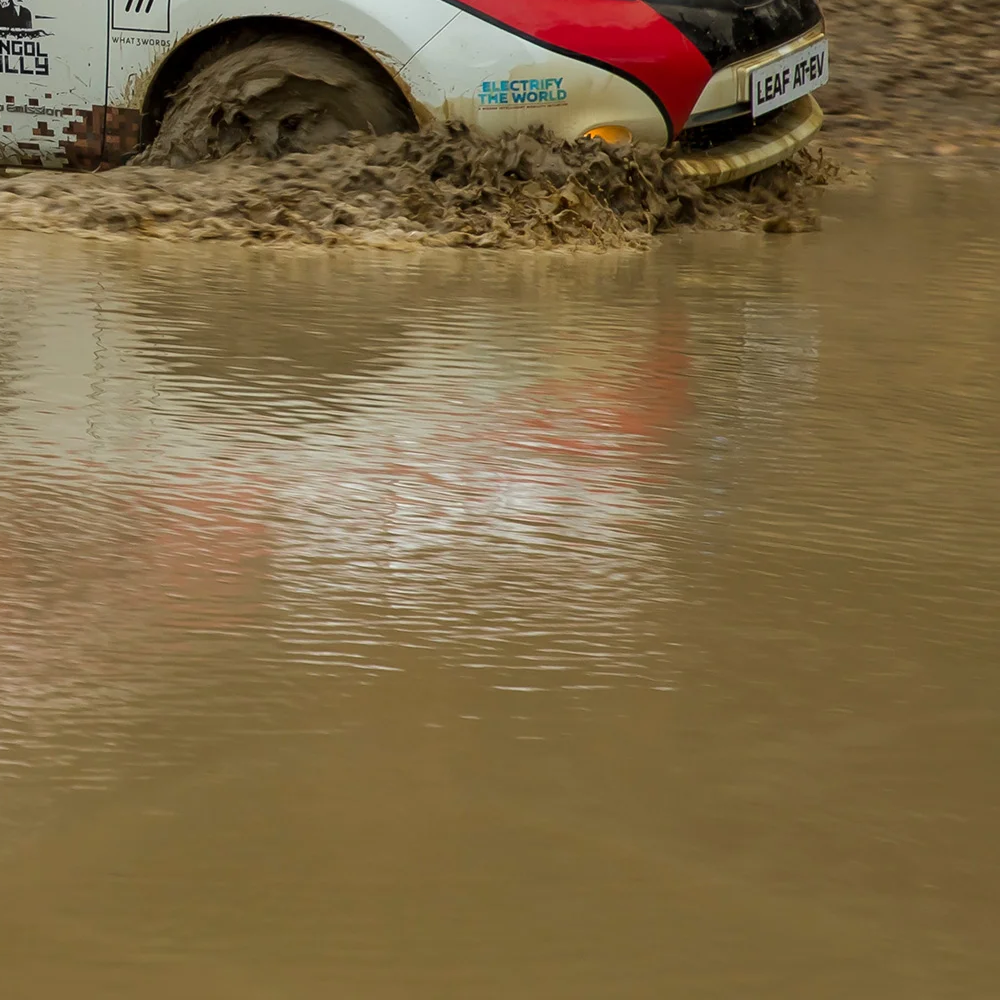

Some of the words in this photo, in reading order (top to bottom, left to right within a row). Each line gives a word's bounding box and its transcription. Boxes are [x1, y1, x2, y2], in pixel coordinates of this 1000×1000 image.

[482, 77, 563, 92] ELECTRIFY
[757, 68, 790, 105] LEAF
[793, 51, 825, 90] AT-EV
[478, 92, 508, 104] THE
[511, 89, 567, 103] WORLD
